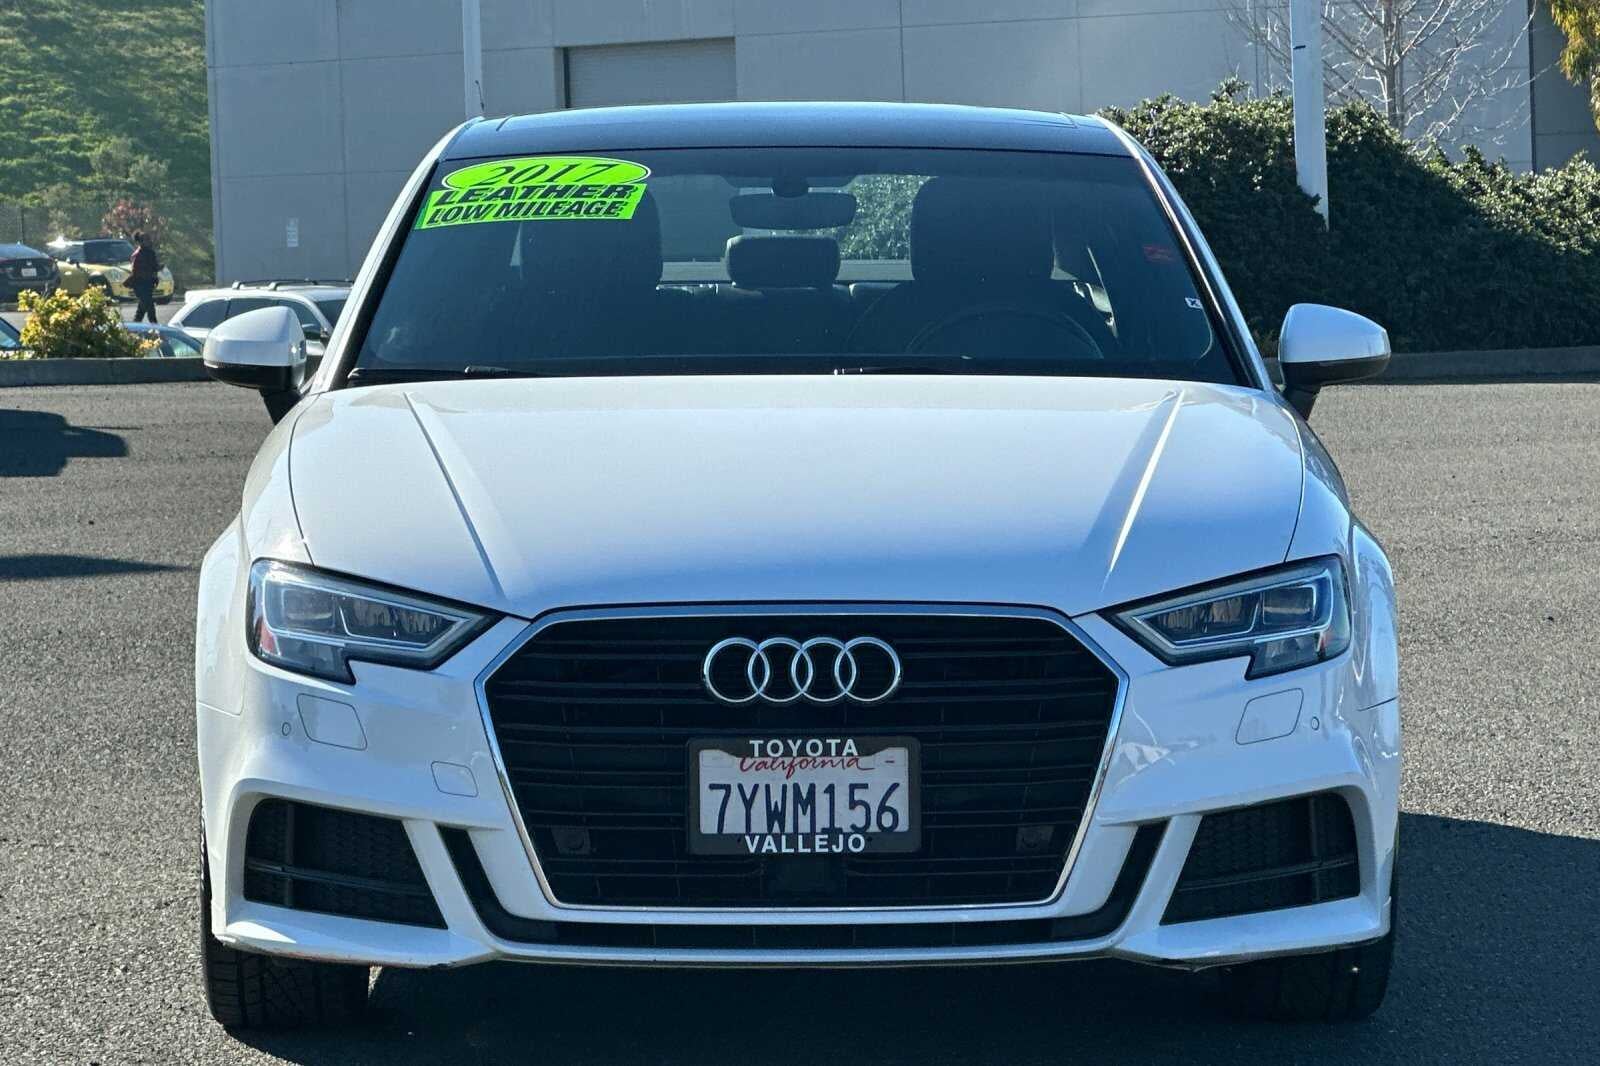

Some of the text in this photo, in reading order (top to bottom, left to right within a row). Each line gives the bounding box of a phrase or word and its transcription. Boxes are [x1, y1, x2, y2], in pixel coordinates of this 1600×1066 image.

[470, 163, 620, 186] 2017
[433, 184, 636, 207] LEATHER
[426, 200, 623, 226] LOW MILEAGE
[749, 739, 858, 757] TOYOTA
[738, 757, 875, 779] California
[708, 782, 900, 833] 7YWM156
[745, 834, 865, 853] VALLEJO
